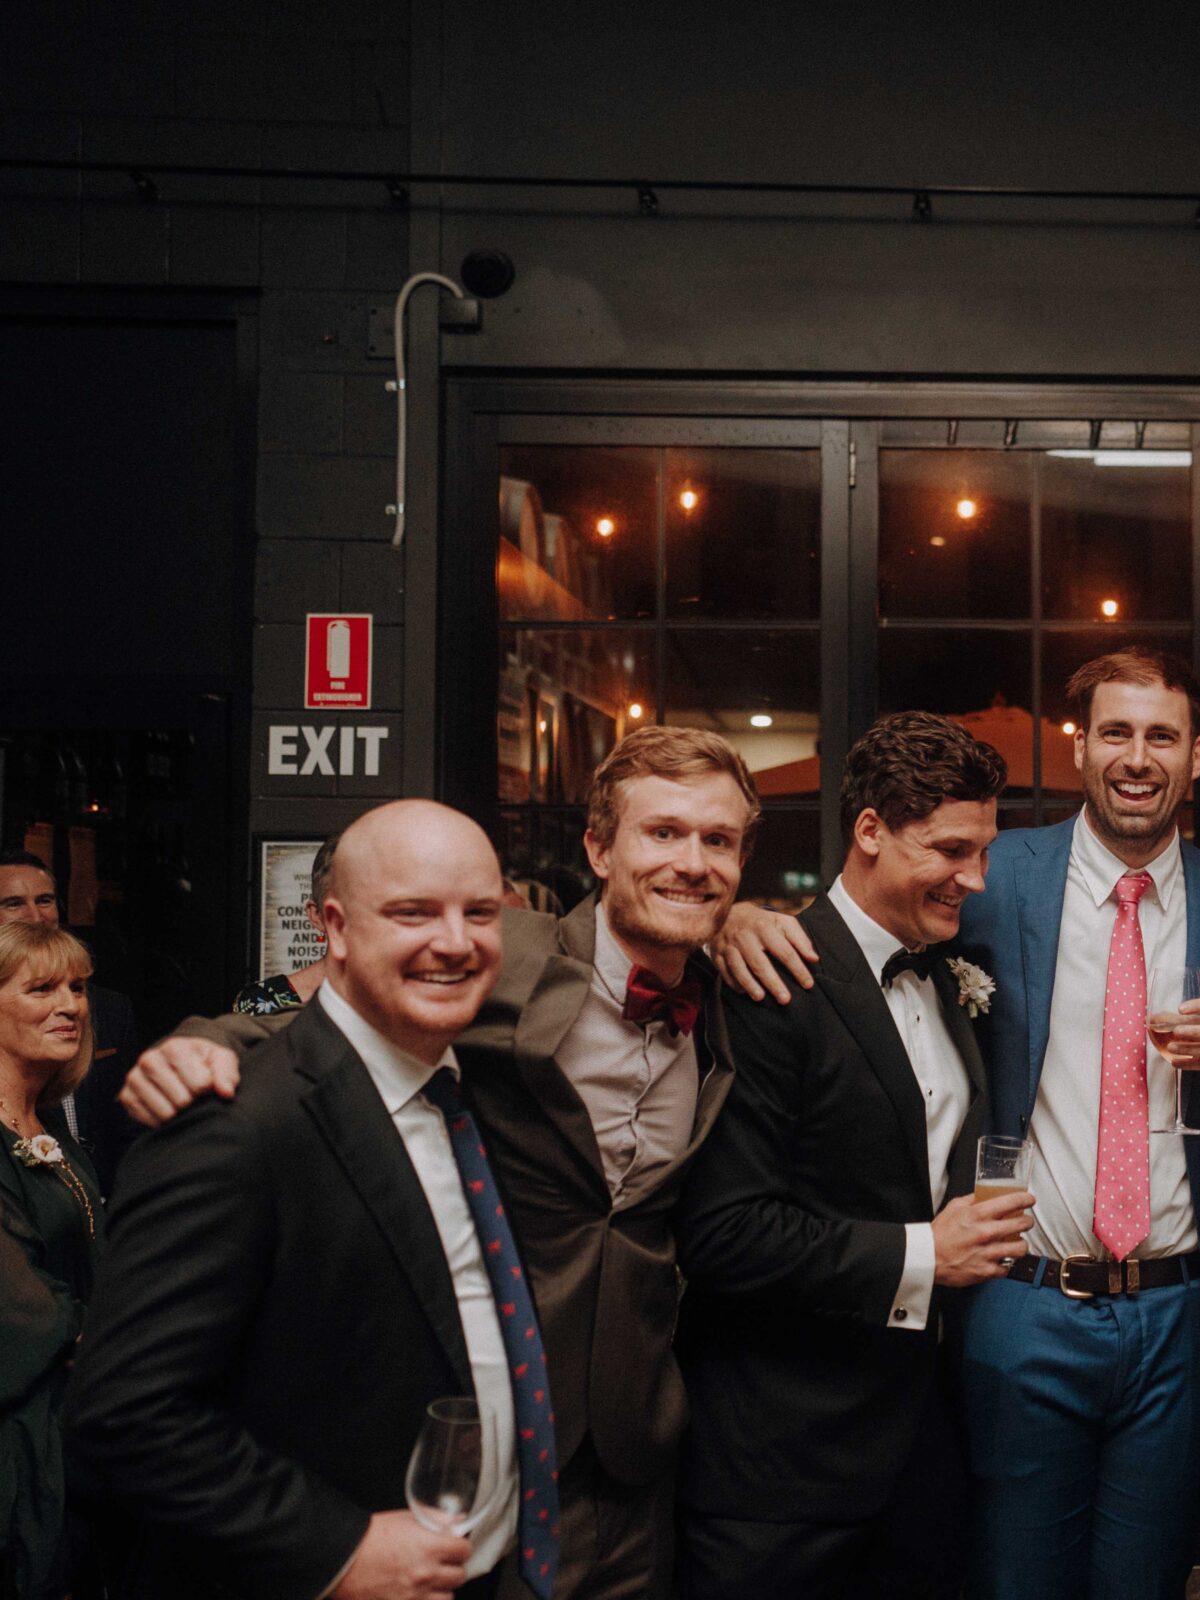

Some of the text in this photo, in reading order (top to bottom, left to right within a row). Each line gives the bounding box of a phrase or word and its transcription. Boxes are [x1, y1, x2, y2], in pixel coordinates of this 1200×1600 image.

[268, 725, 389, 776] EXIT
[282, 919, 312, 930] NEIG
[288, 946, 326, 957] NOISE
[292, 960, 318, 970] MIN
